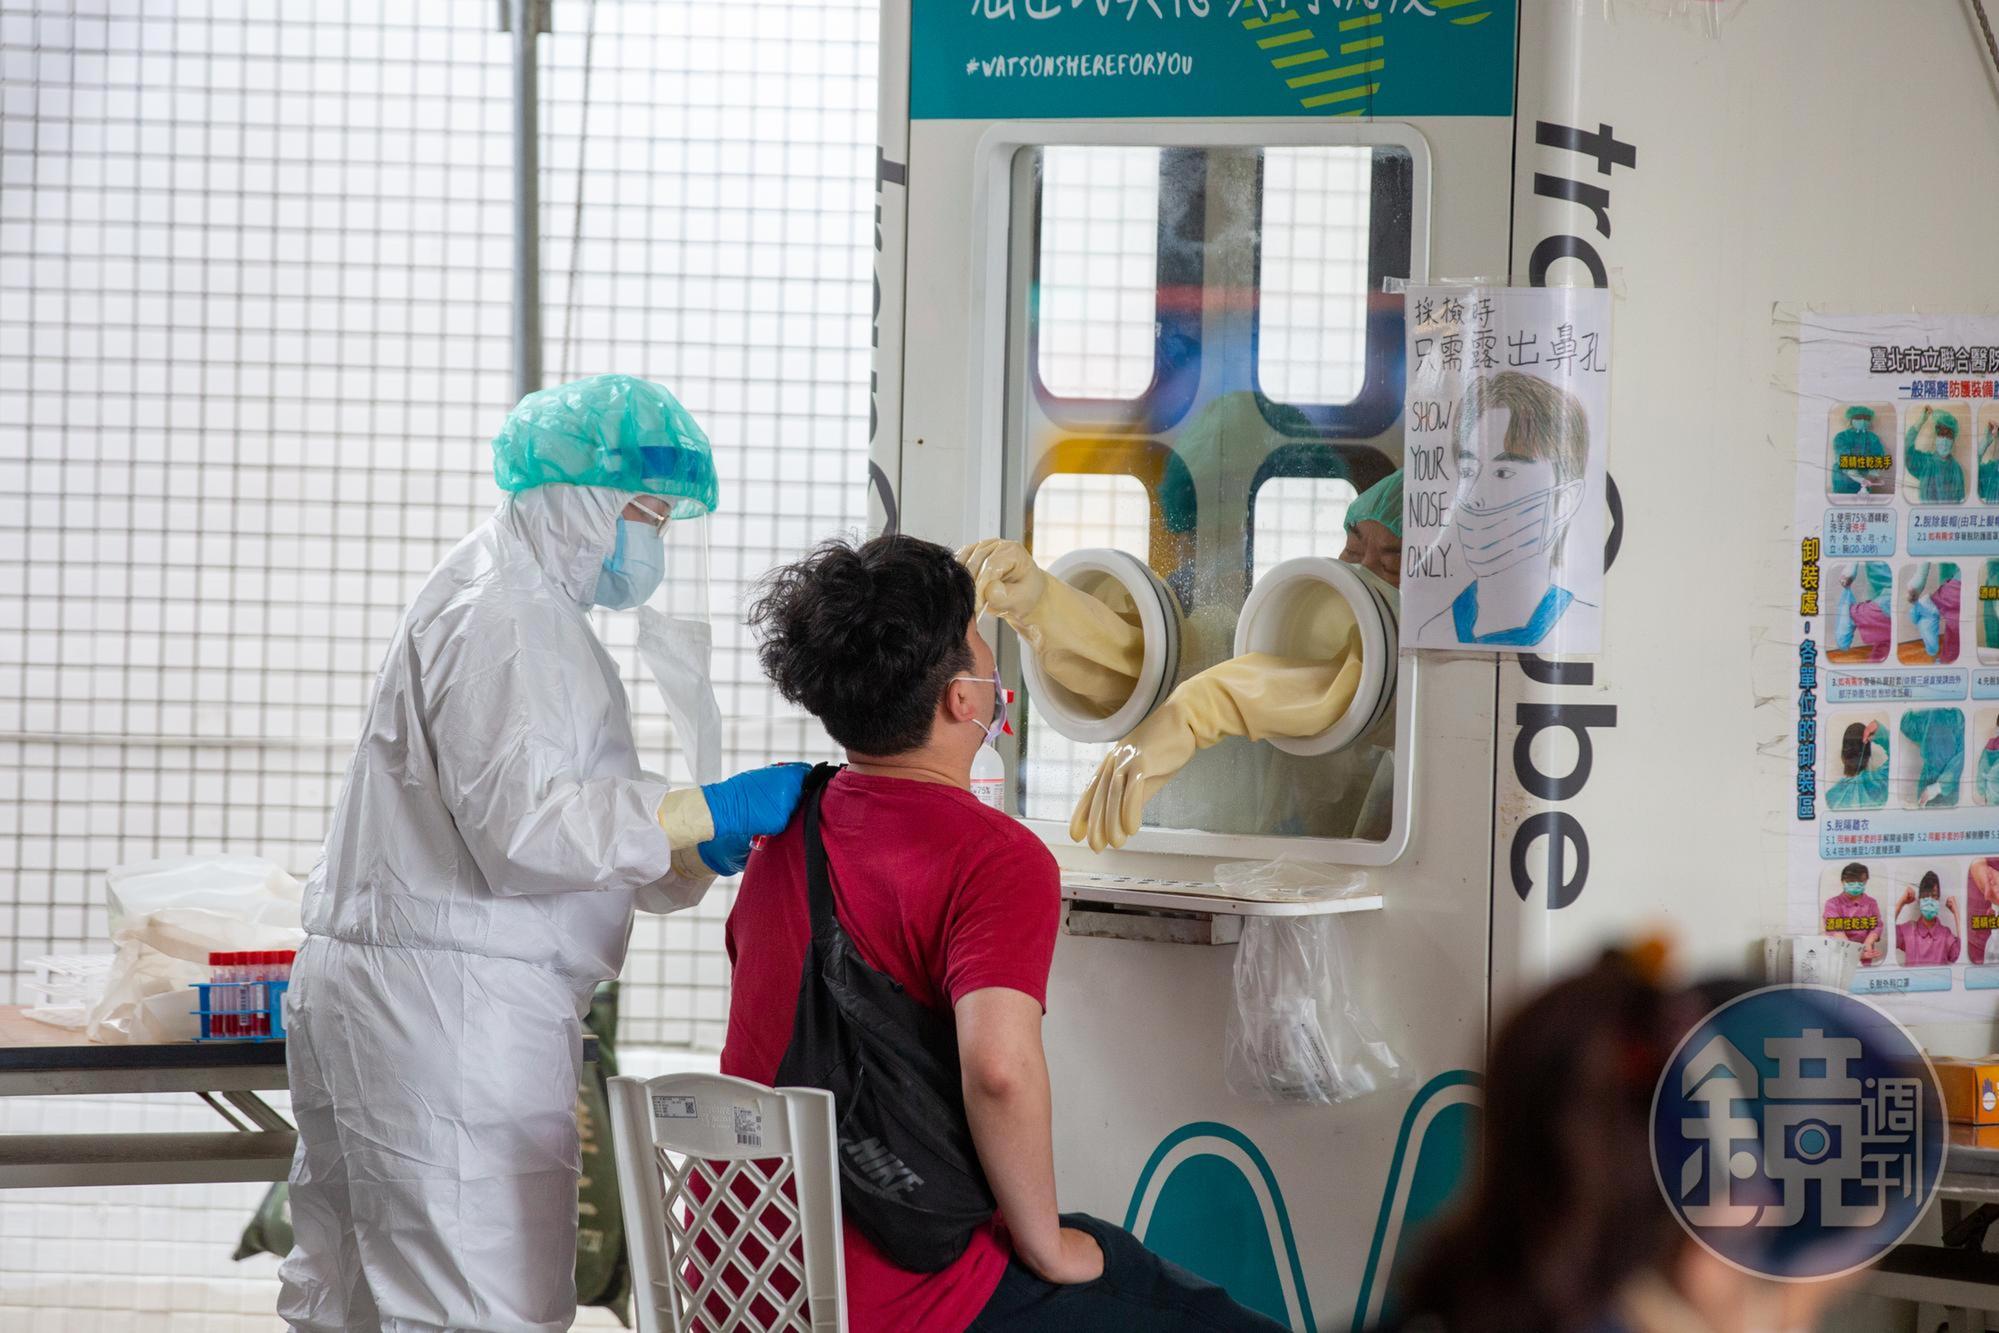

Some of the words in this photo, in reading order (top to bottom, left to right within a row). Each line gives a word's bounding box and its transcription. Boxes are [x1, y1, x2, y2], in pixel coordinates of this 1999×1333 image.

[966, 53, 1194, 77] #WATSONSHEREFORYOU
[1414, 296, 1496, 328] 採檢時
[1414, 322, 1607, 377] 只需露出鼻孔
[1411, 401, 1453, 432] SHOW
[1409, 446, 1450, 481] YOUR
[1408, 491, 1449, 529] NOSE
